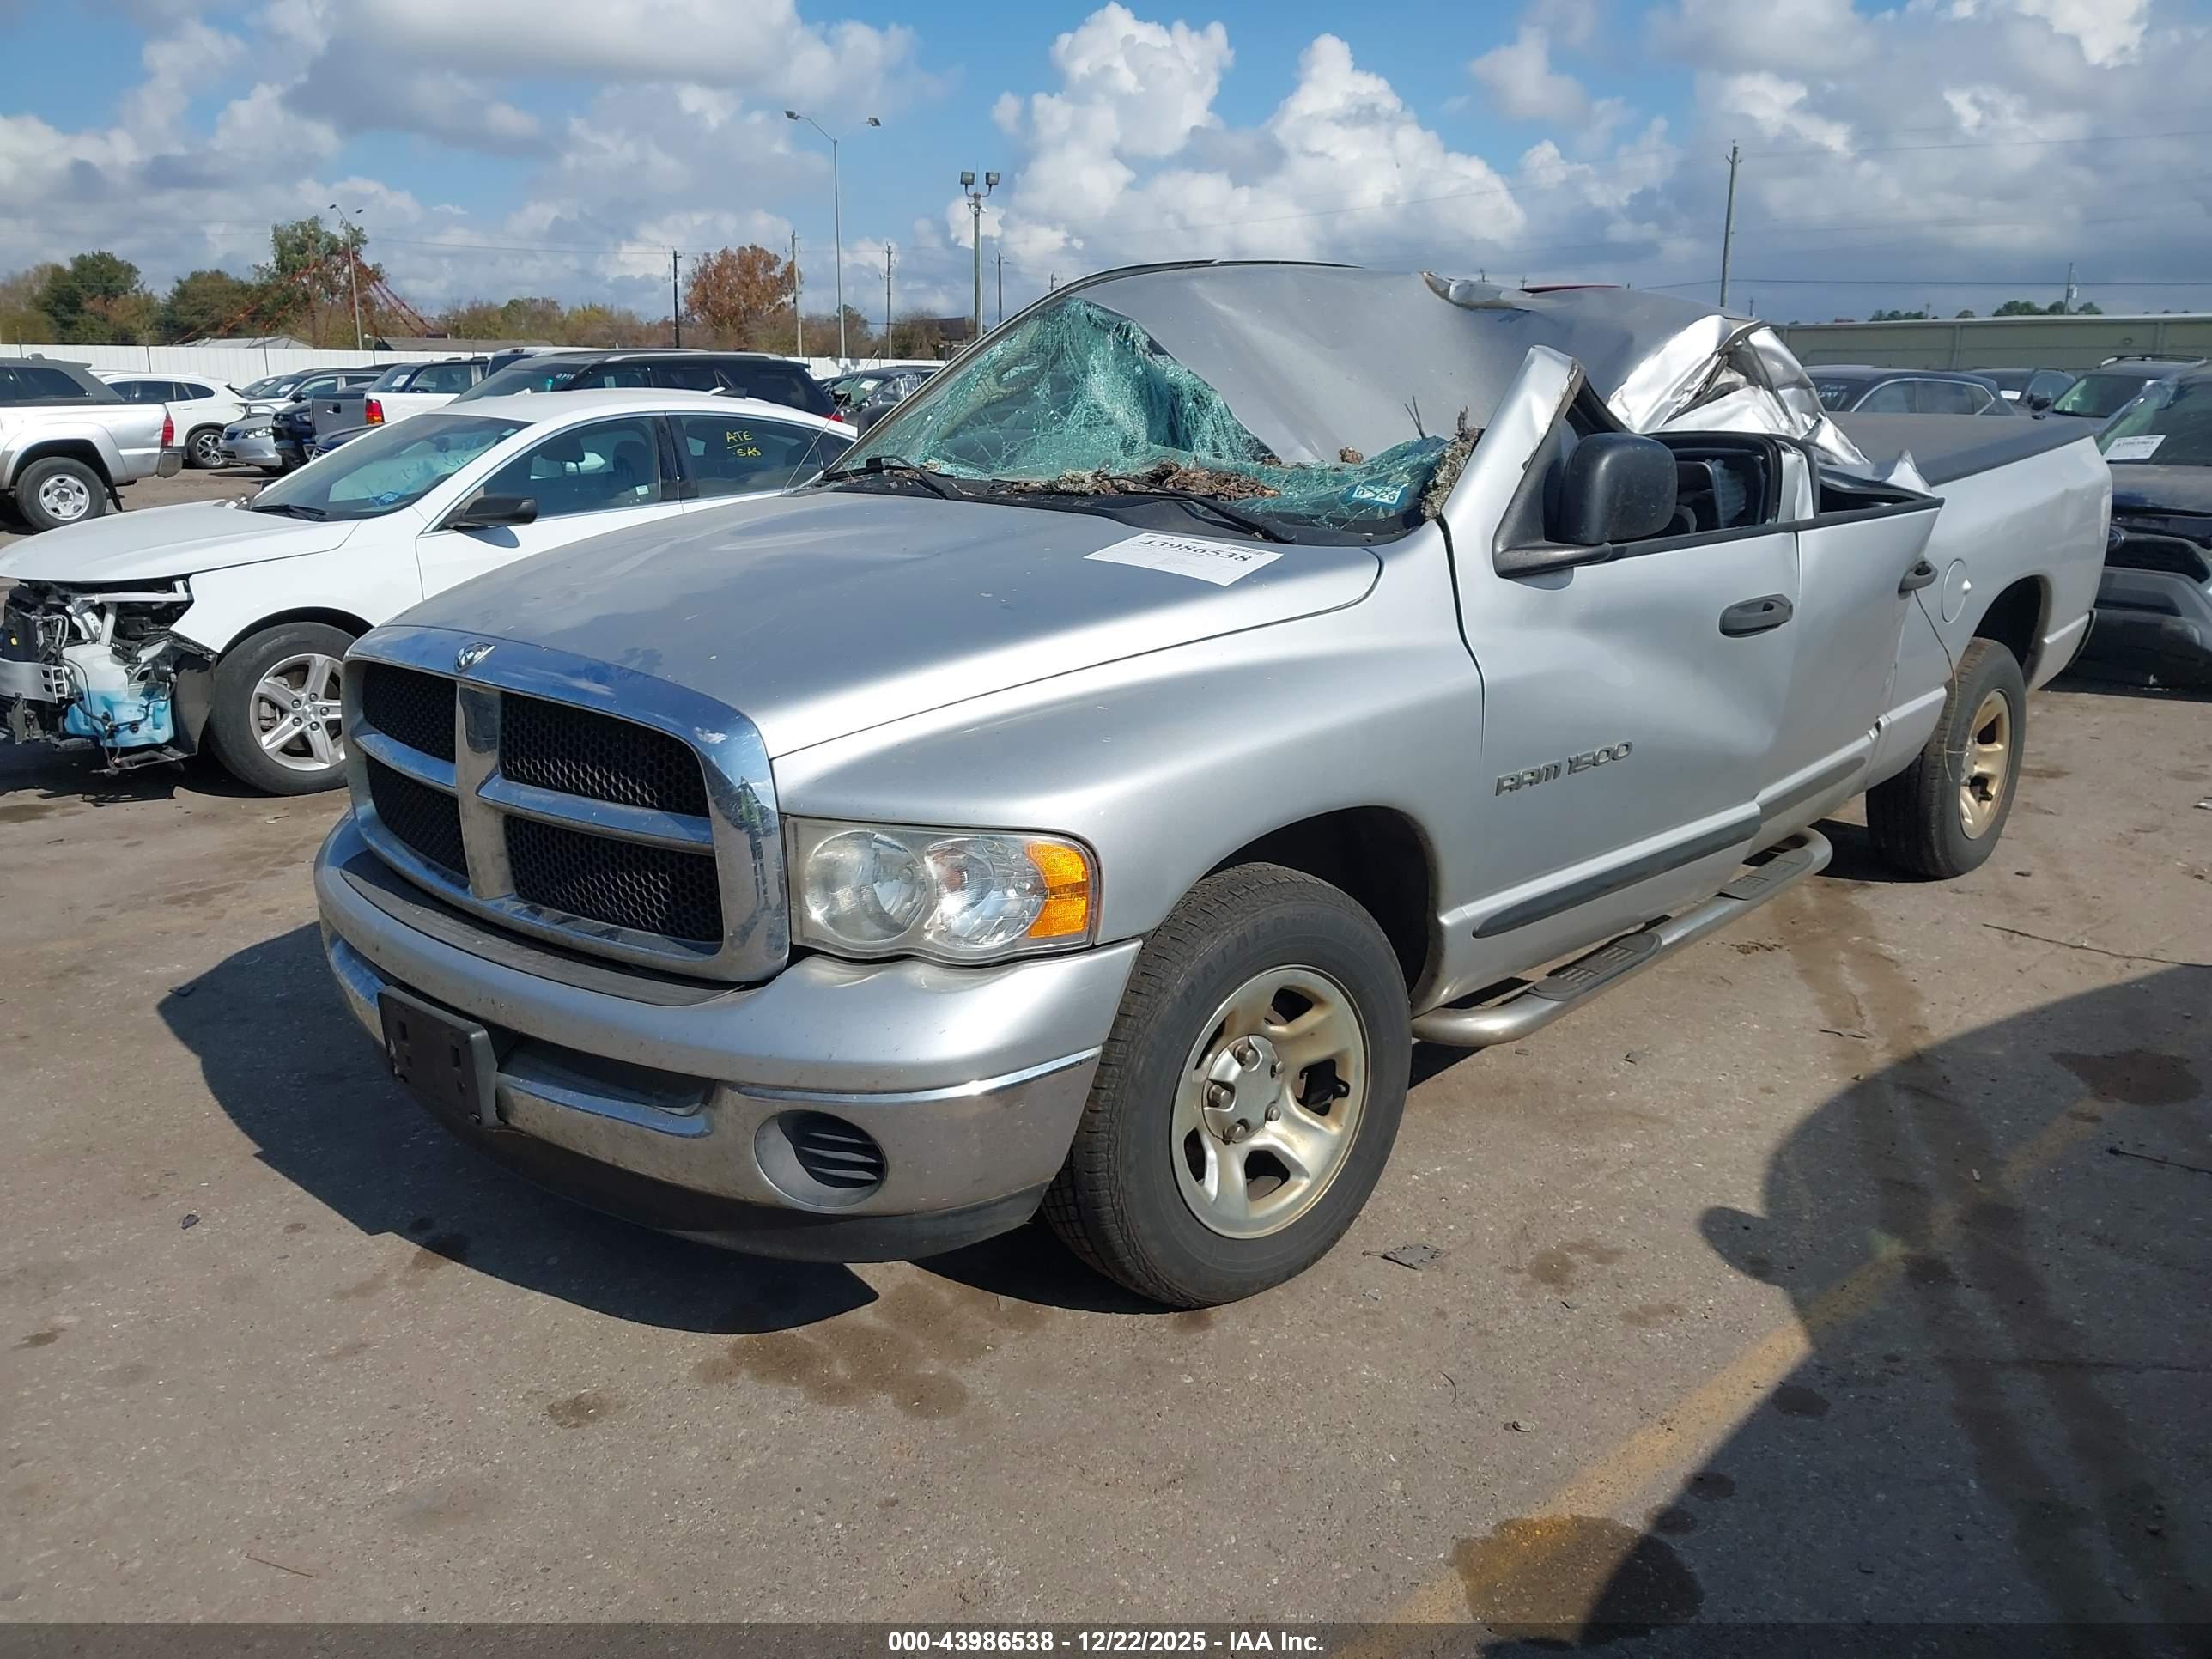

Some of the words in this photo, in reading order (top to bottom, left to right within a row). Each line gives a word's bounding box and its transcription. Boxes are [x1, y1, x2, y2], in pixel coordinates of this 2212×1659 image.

[726, 430, 753, 443] ATE
[1379, 490, 1397, 501] 26
[1139, 539, 1253, 562] 43986538
[1495, 760, 1563, 796] RAM
[1567, 740, 1634, 775] 1500
